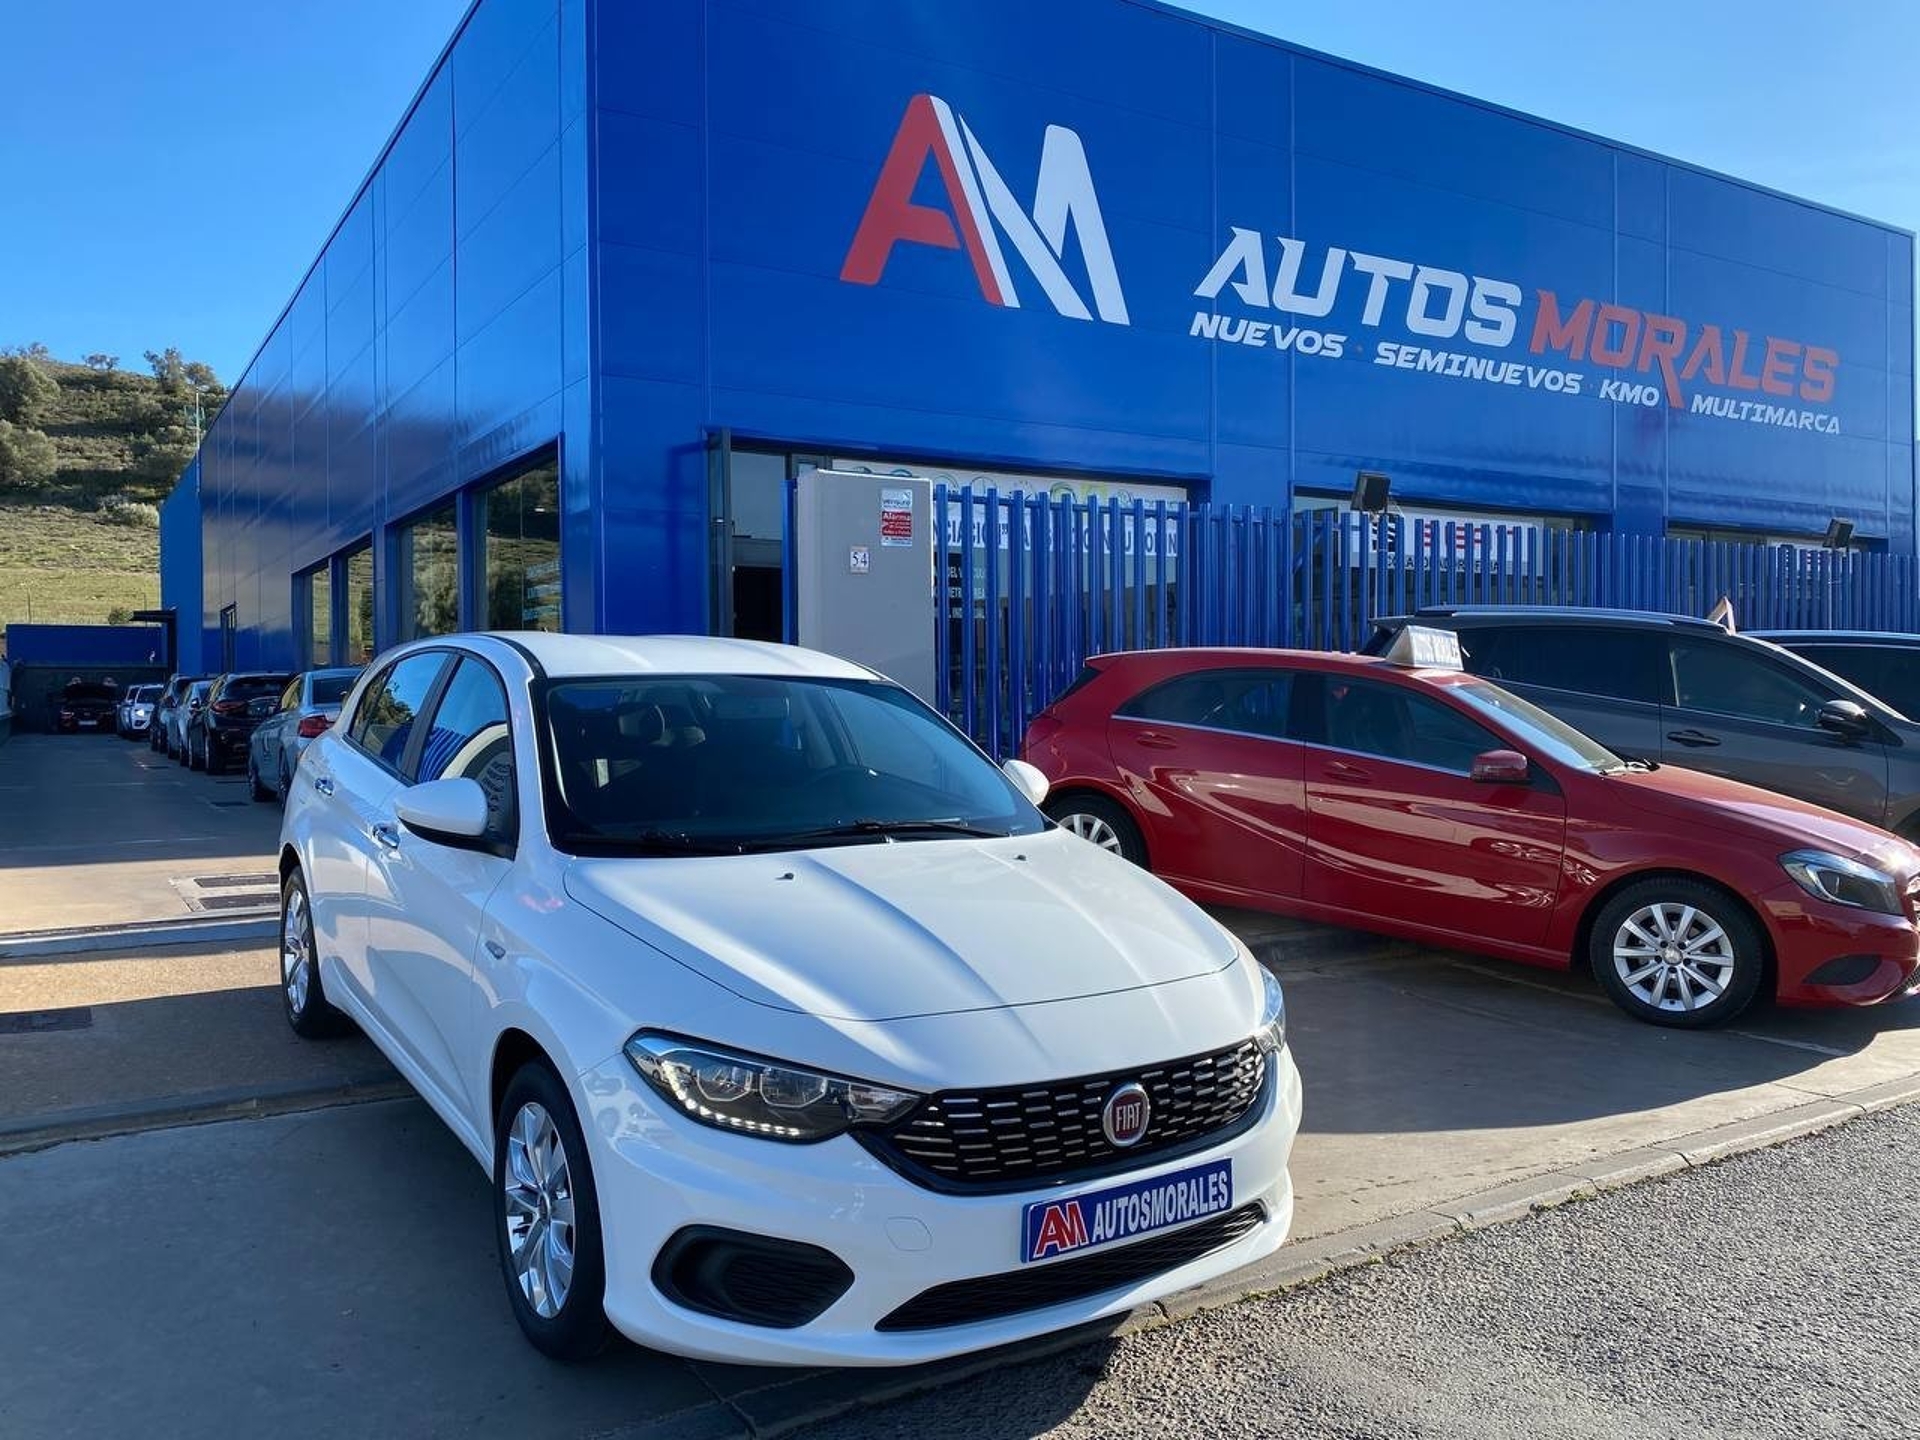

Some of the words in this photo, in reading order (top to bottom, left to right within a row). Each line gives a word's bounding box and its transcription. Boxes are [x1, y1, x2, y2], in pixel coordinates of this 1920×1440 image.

[840, 93, 1130, 326] AM
[1193, 226, 1522, 347] AUTOS
[1529, 288, 1839, 408] MORALES
[1189, 311, 1348, 358] NUEVOS
[1374, 341, 1584, 394] SEMINUEVOS
[1690, 394, 1841, 435] MULTIMARCA
[852, 551, 868, 566] 54
[1115, 1102, 1141, 1132] FIAT
[1033, 1200, 1090, 1259] AM
[1092, 1170, 1229, 1244] AUTOSMORALES
